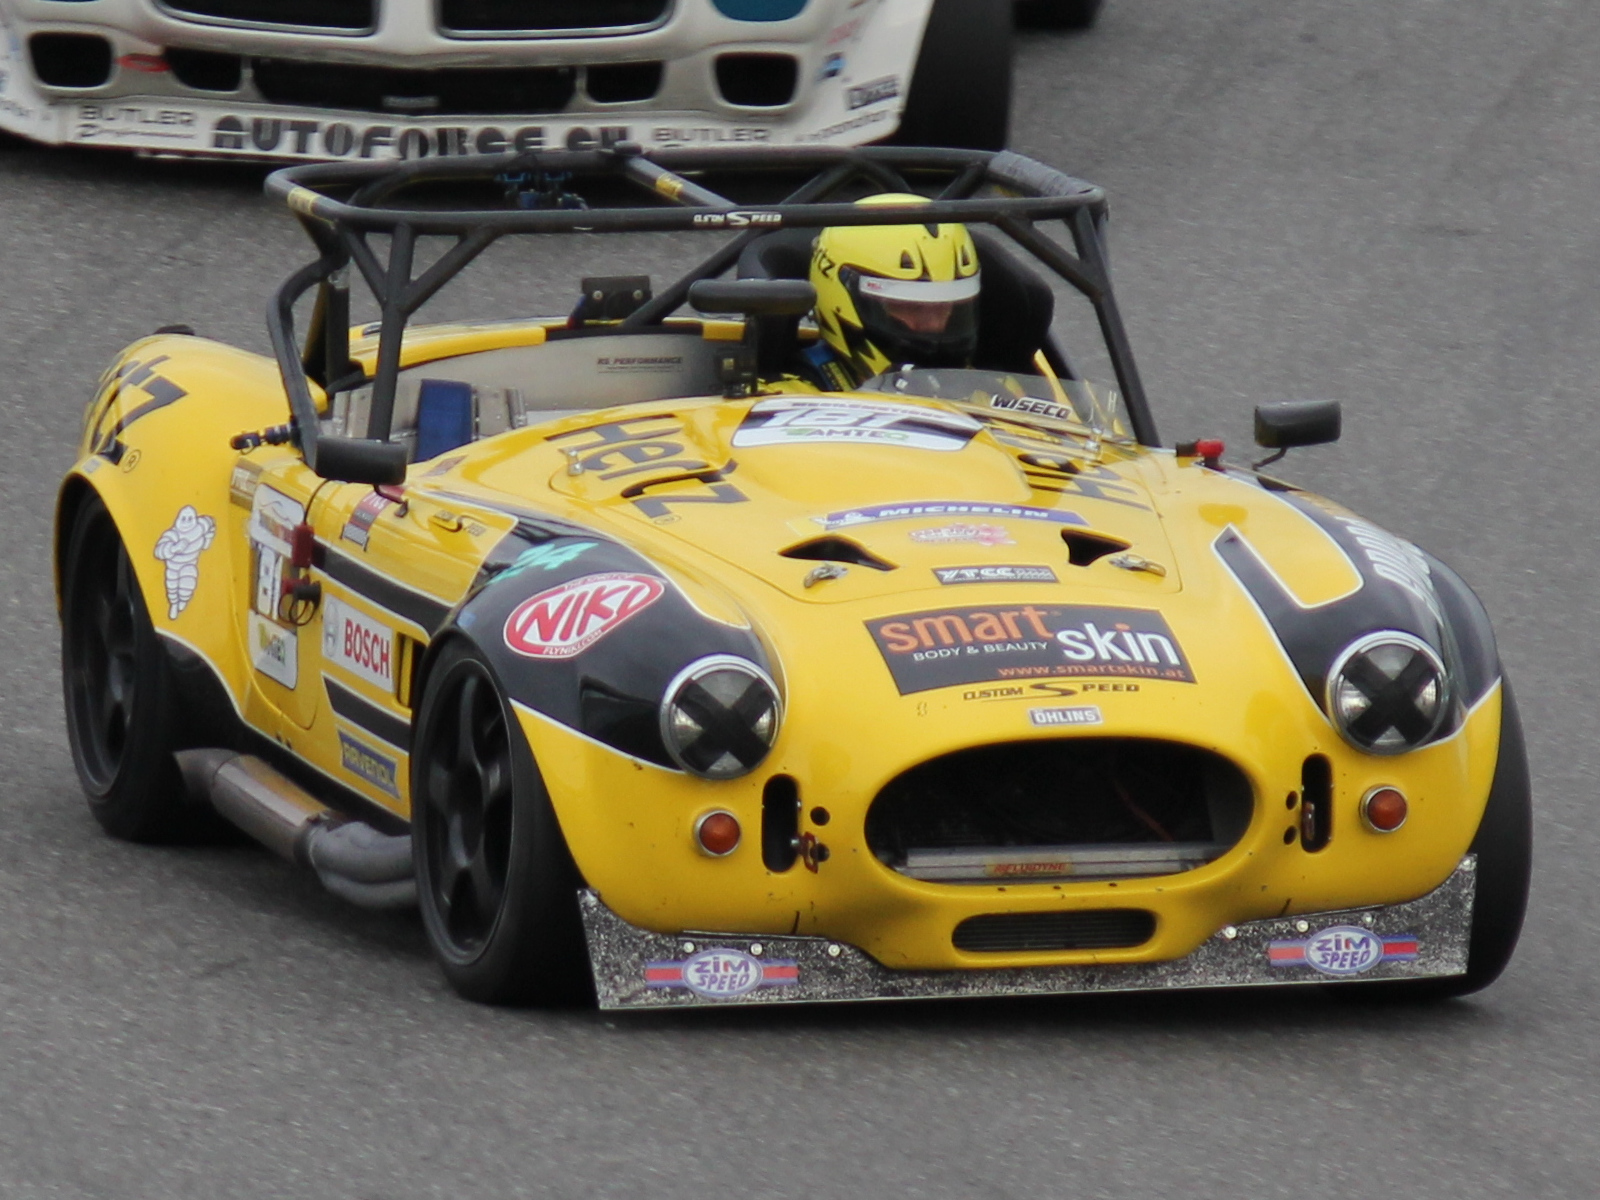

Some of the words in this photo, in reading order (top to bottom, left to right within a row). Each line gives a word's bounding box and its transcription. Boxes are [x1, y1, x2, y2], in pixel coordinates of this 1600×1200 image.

[78, 105, 194, 126] BUTLER
[652, 126, 769, 142] BUTLER
[993, 395, 1071, 420] WISECO
[878, 505, 1050, 519] MICHELIN
[879, 604, 1054, 652] smart
[343, 617, 391, 680] BOSCH
[912, 645, 962, 663] BODY
[966, 645, 980, 656] &
[983, 640, 1049, 655] BEAUTY
[1056, 622, 1182, 666] skin
[996, 662, 1188, 680] www.smartskin.at
[963, 687, 1024, 701] CUSTOM
[1029, 680, 1140, 700] SPEED
[1034, 708, 1098, 725] ÖHLINS
[1318, 950, 1371, 968] SPEED
[696, 972, 750, 992] SPEED
